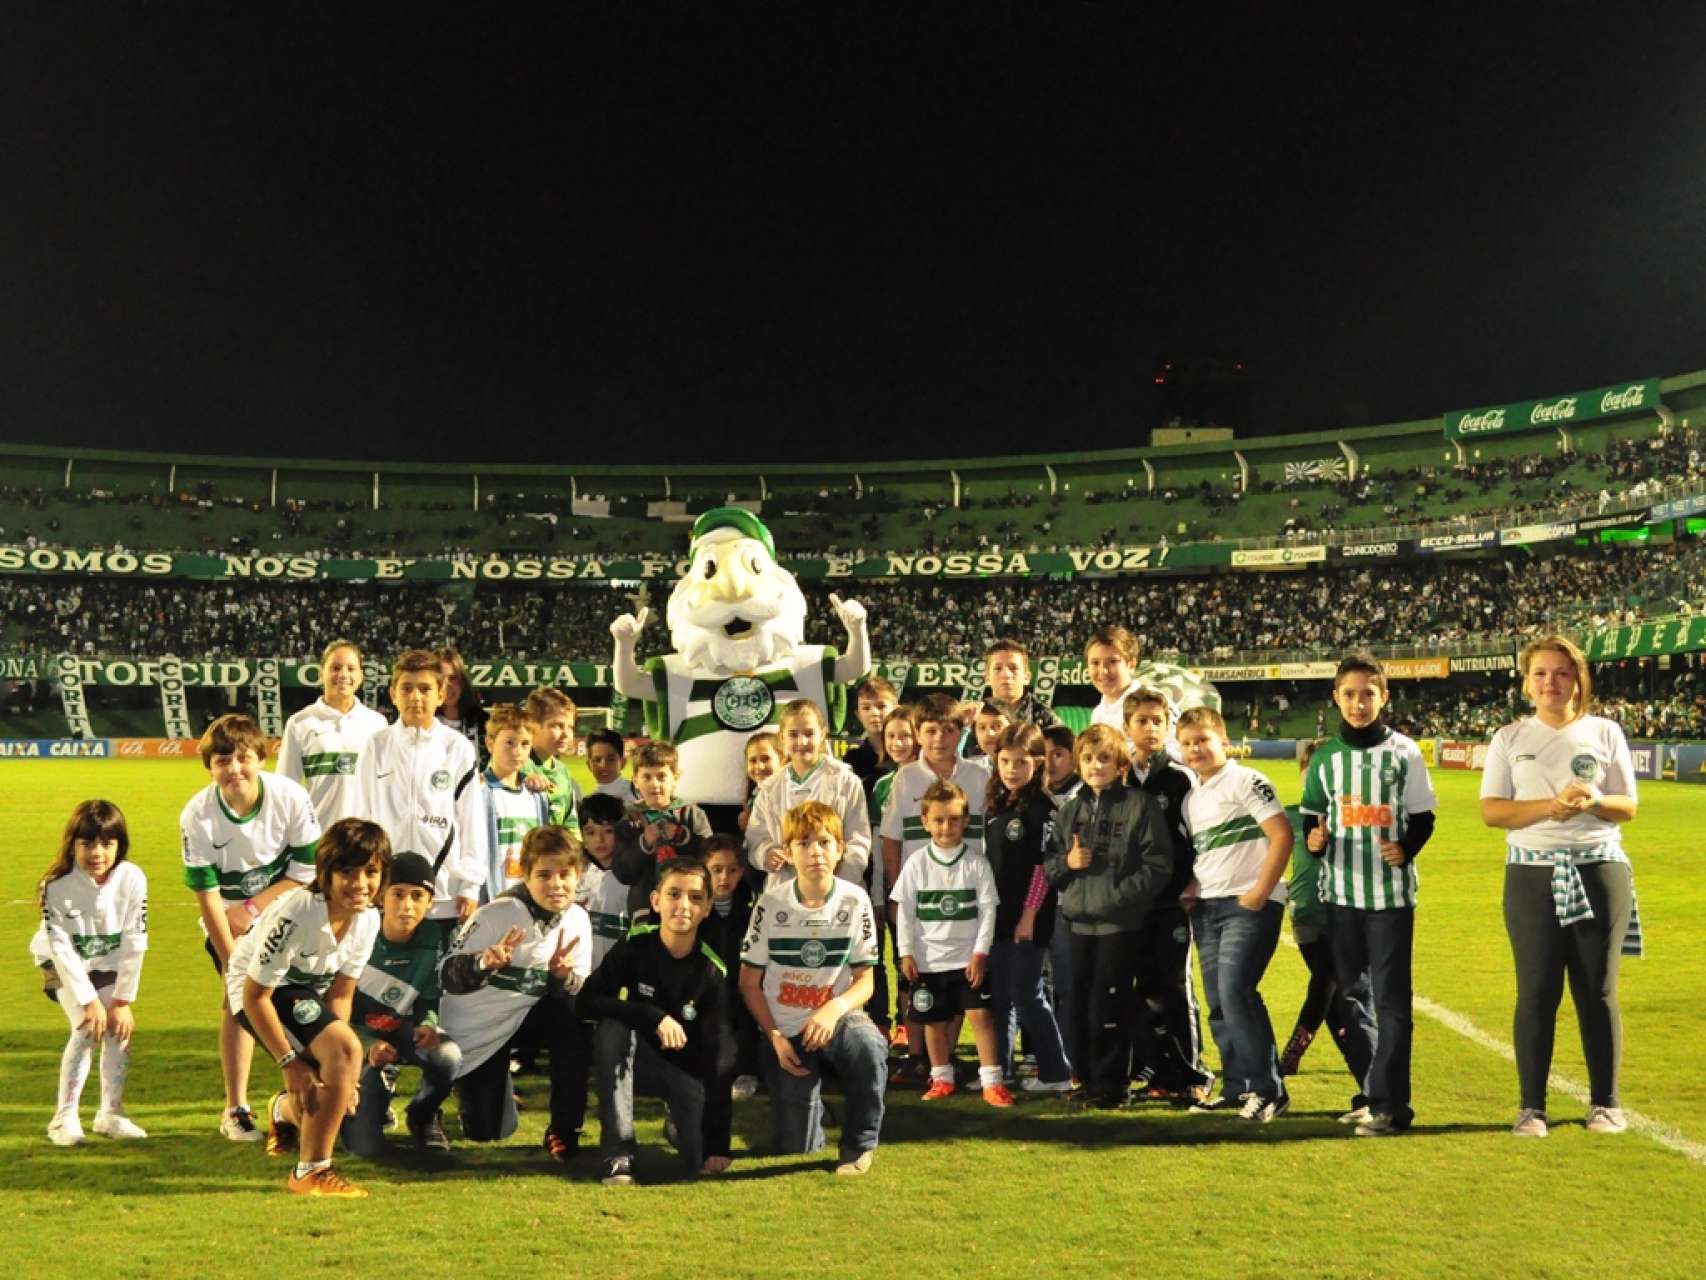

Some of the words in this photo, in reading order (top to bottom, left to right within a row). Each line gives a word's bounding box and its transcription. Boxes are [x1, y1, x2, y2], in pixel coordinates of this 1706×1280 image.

[1530, 397, 1578, 425] Coca-Cola
[1600, 384, 1646, 413] Coca-Cola
[1458, 409, 1506, 433] Coca-Cola
[0, 548, 173, 574] SOMOS
[451, 560, 605, 579] NOSSA
[886, 552, 1030, 575] NOSSA
[1451, 655, 1515, 672] NUTRILATINA
[50, 742, 105, 756] CAIXA
[1341, 803, 1393, 828] BMG
